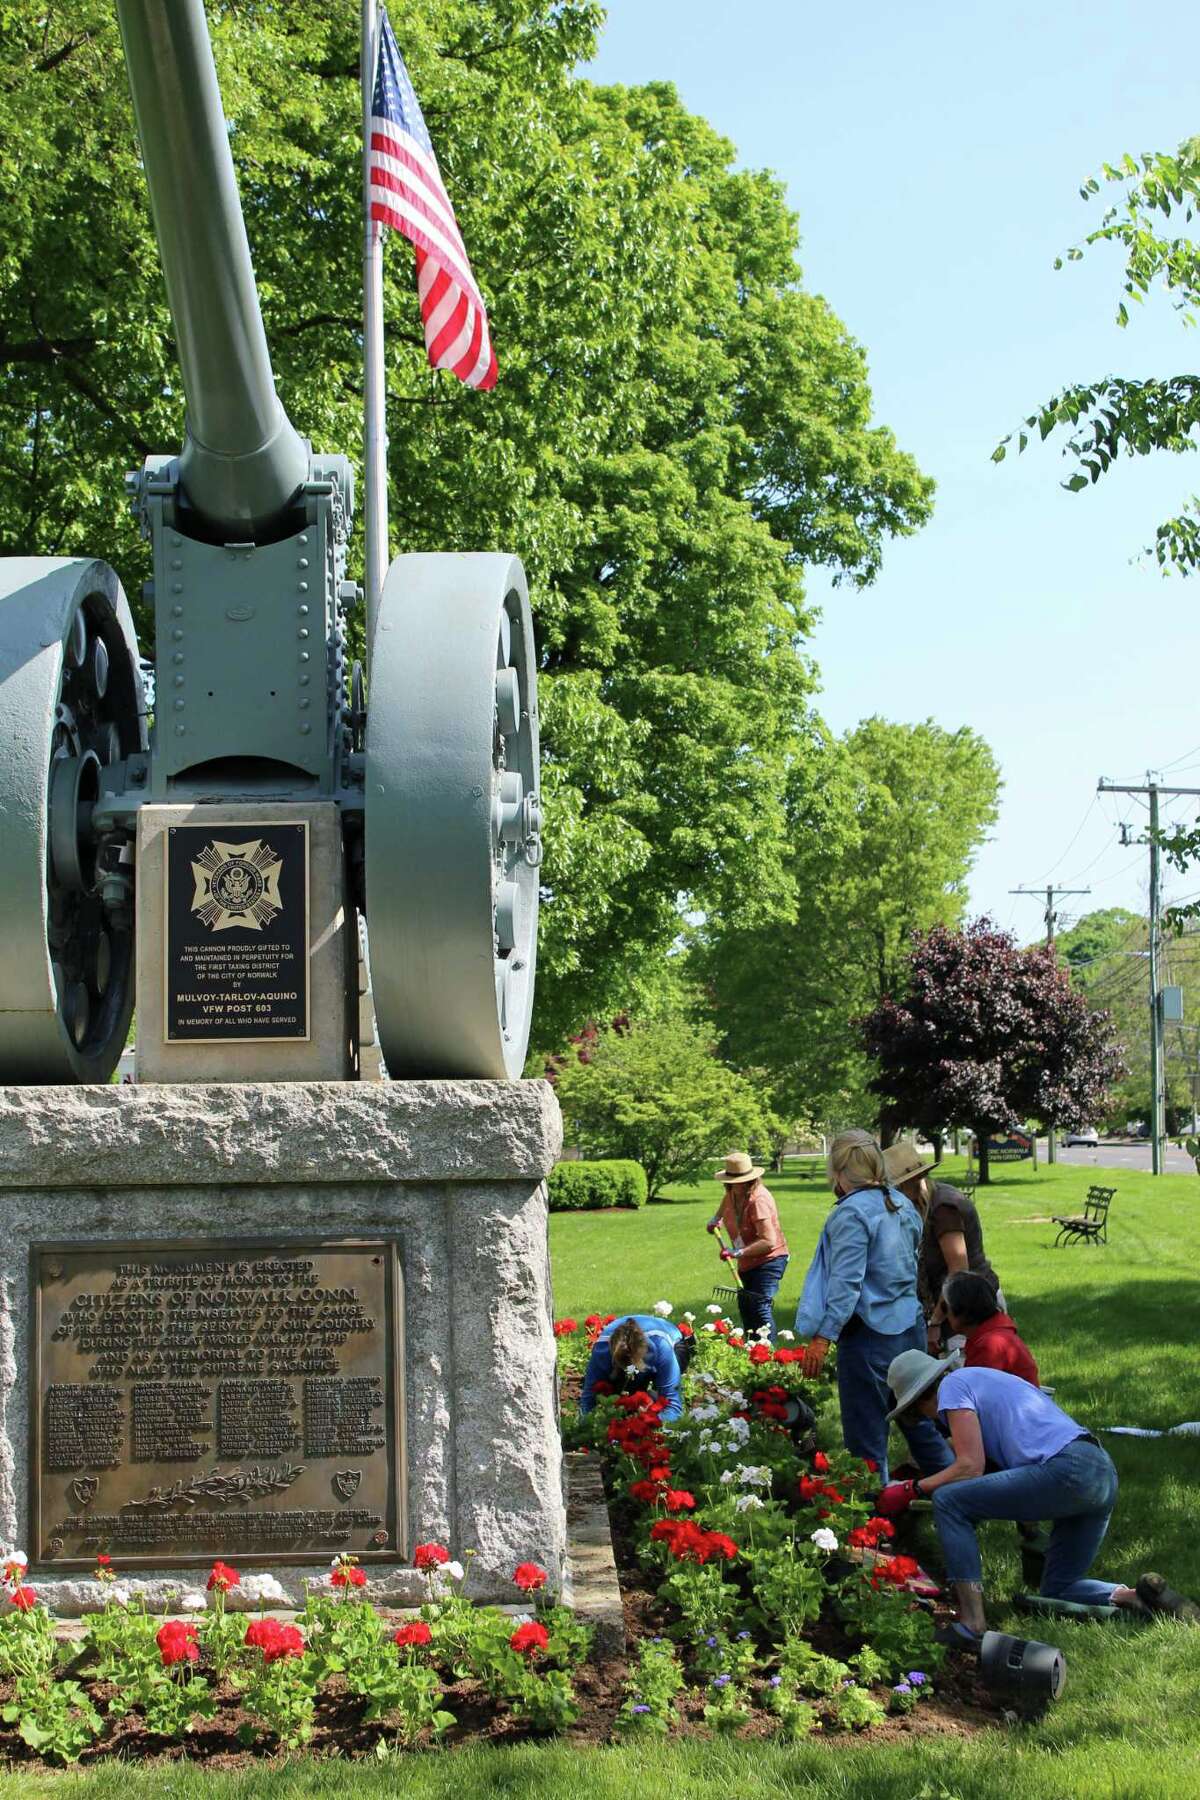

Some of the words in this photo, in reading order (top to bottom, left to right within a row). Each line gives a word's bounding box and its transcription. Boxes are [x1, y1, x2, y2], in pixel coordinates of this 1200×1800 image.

[199, 945, 226, 953] CANNON
[177, 992, 297, 1002] MULVOY-TARLOV-AQUINO
[203, 1005, 224, 1013] VFW
[255, 1004, 272, 1012] 603
[120, 1263, 148, 1275] THIS
[153, 1261, 233, 1273] MONUMENT
[237, 1260, 250, 1271] IS
[255, 1259, 315, 1271] ERECTED
[112, 1277, 129, 1289] AS
[144, 1275, 200, 1288] TRIBUTE
[204, 1274, 222, 1286] OF
[224, 1273, 271, 1285] HONOR
[273, 1272, 293, 1284] TO
[293, 1271, 319, 1284] THE
[75, 1292, 164, 1307] CITIZENS
[170, 1291, 193, 1305] OF
[197, 1288, 297, 1304] NORWALK
[63, 1311, 98, 1322] WHO
[103, 1310, 166, 1321] DEVOTED
[171, 1307, 264, 1320] THEMSELVES
[268, 1306, 286, 1317] TO
[289, 1305, 316, 1317] THE
[321, 1304, 365, 1316] CAUSE
[57, 1324, 75, 1336] OF
[78, 1323, 143, 1335] FREEDOM
[146, 1321, 165, 1333] IN
[170, 1321, 196, 1332] THE
[201, 1319, 257, 1332] SERVICE
[262, 1319, 280, 1331] OF
[283, 1318, 310, 1330] OUR
[315, 1317, 376, 1329] COUNTRY
[82, 1337, 131, 1348] DURING
[136, 1335, 161, 1347] THE
[162, 1334, 205, 1346] GREAT
[207, 1333, 253, 1345] WORLD
[257, 1332, 288, 1344] WAR
[103, 1351, 129, 1363] AND
[138, 1350, 151, 1362] AS
[167, 1349, 242, 1361] MEMORIAL
[248, 1347, 266, 1359] TO
[273, 1347, 298, 1359] THE
[303, 1346, 336, 1358] MEN
[92, 1365, 124, 1376] WHO
[129, 1364, 168, 1376] MADE
[172, 1362, 198, 1374] THE
[202, 1361, 265, 1373] SUPREME
[272, 1359, 341, 1372] SACRIFICE
